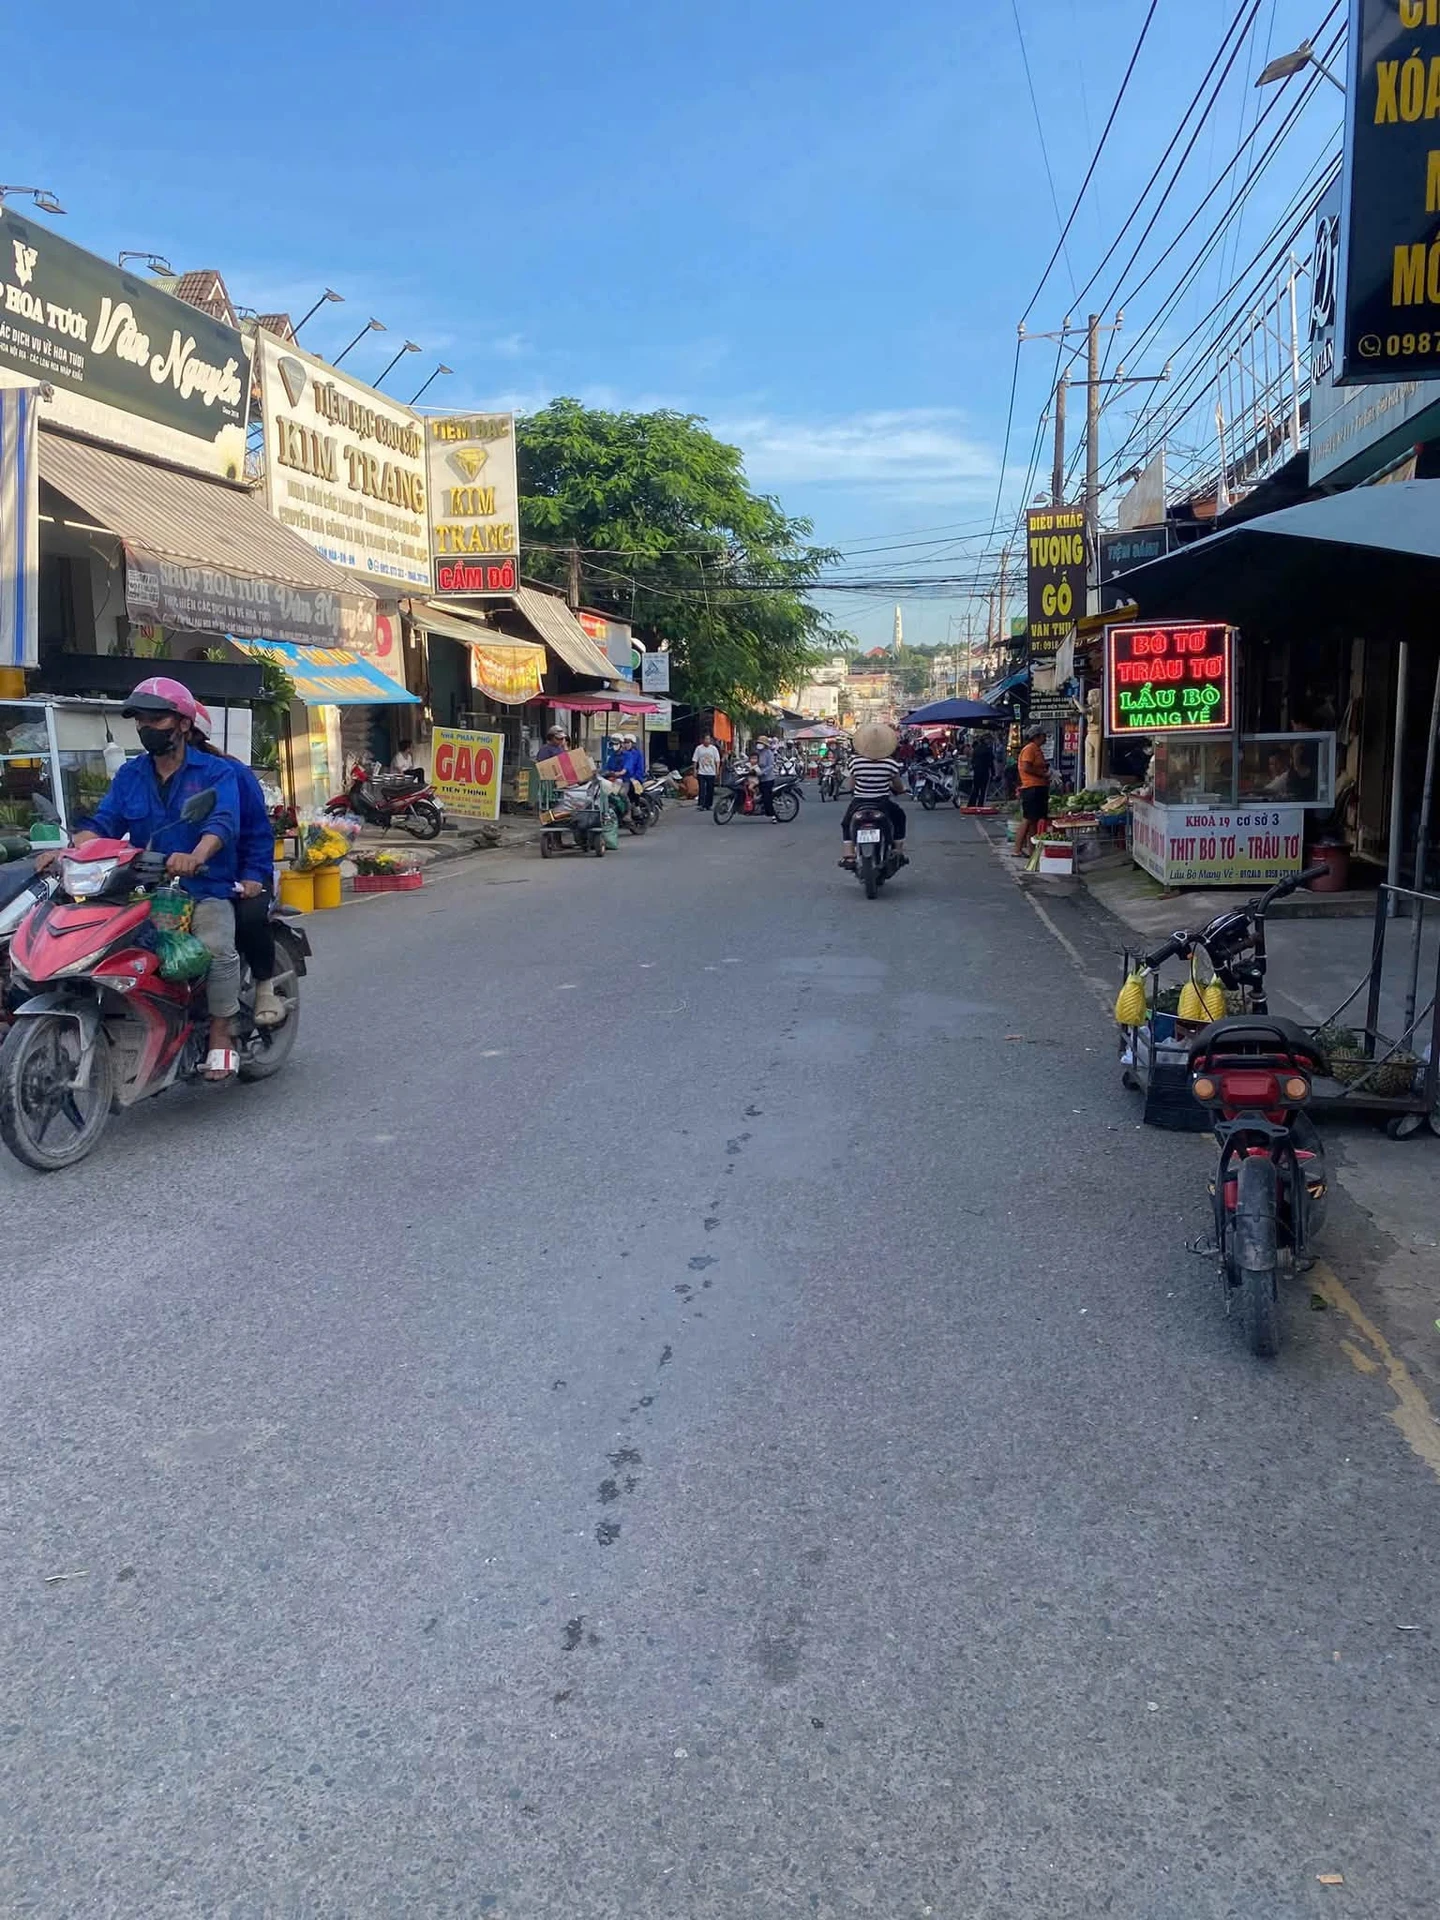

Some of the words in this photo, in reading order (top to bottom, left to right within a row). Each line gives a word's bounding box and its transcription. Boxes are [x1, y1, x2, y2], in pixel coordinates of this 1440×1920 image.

[5, 284, 44, 325] HOA
[47, 302, 88, 342] TƯƠI
[12, 328, 30, 348] DỊCH
[312, 380, 349, 426] TIỆM
[432, 418, 471, 442] TIỆM
[275, 415, 340, 483] KIM
[343, 444, 426, 514] TRANG
[449, 486, 495, 516] KIM
[435, 523, 515, 554] TRANG
[201, 569, 235, 599] HOA
[440, 559, 483, 590] CẦM
[487, 559, 514, 590] ĐỒ
[1132, 630, 1167, 655] BÒ
[1174, 630, 1207, 653] TƠ
[1117, 657, 1183, 682] TRÂU
[1190, 655, 1223, 678] TƠ
[1182, 683, 1221, 706] BÒ
[1129, 711, 1182, 727] MANG
[1187, 705, 1210, 723] VỀ
[436, 743, 494, 786] GẠO
[1219, 816, 1231, 828] 19
[1236, 814, 1252, 827] CƠ
[1254, 812, 1269, 827] SỞ
[1272, 813, 1280, 826] 3
[1170, 838, 1196, 865] THỊT
[1200, 832, 1217, 860] BÒ
[1220, 834, 1236, 860] TƠ
[1247, 831, 1280, 860] TRÂU
[1284, 833, 1300, 859] TƠ
